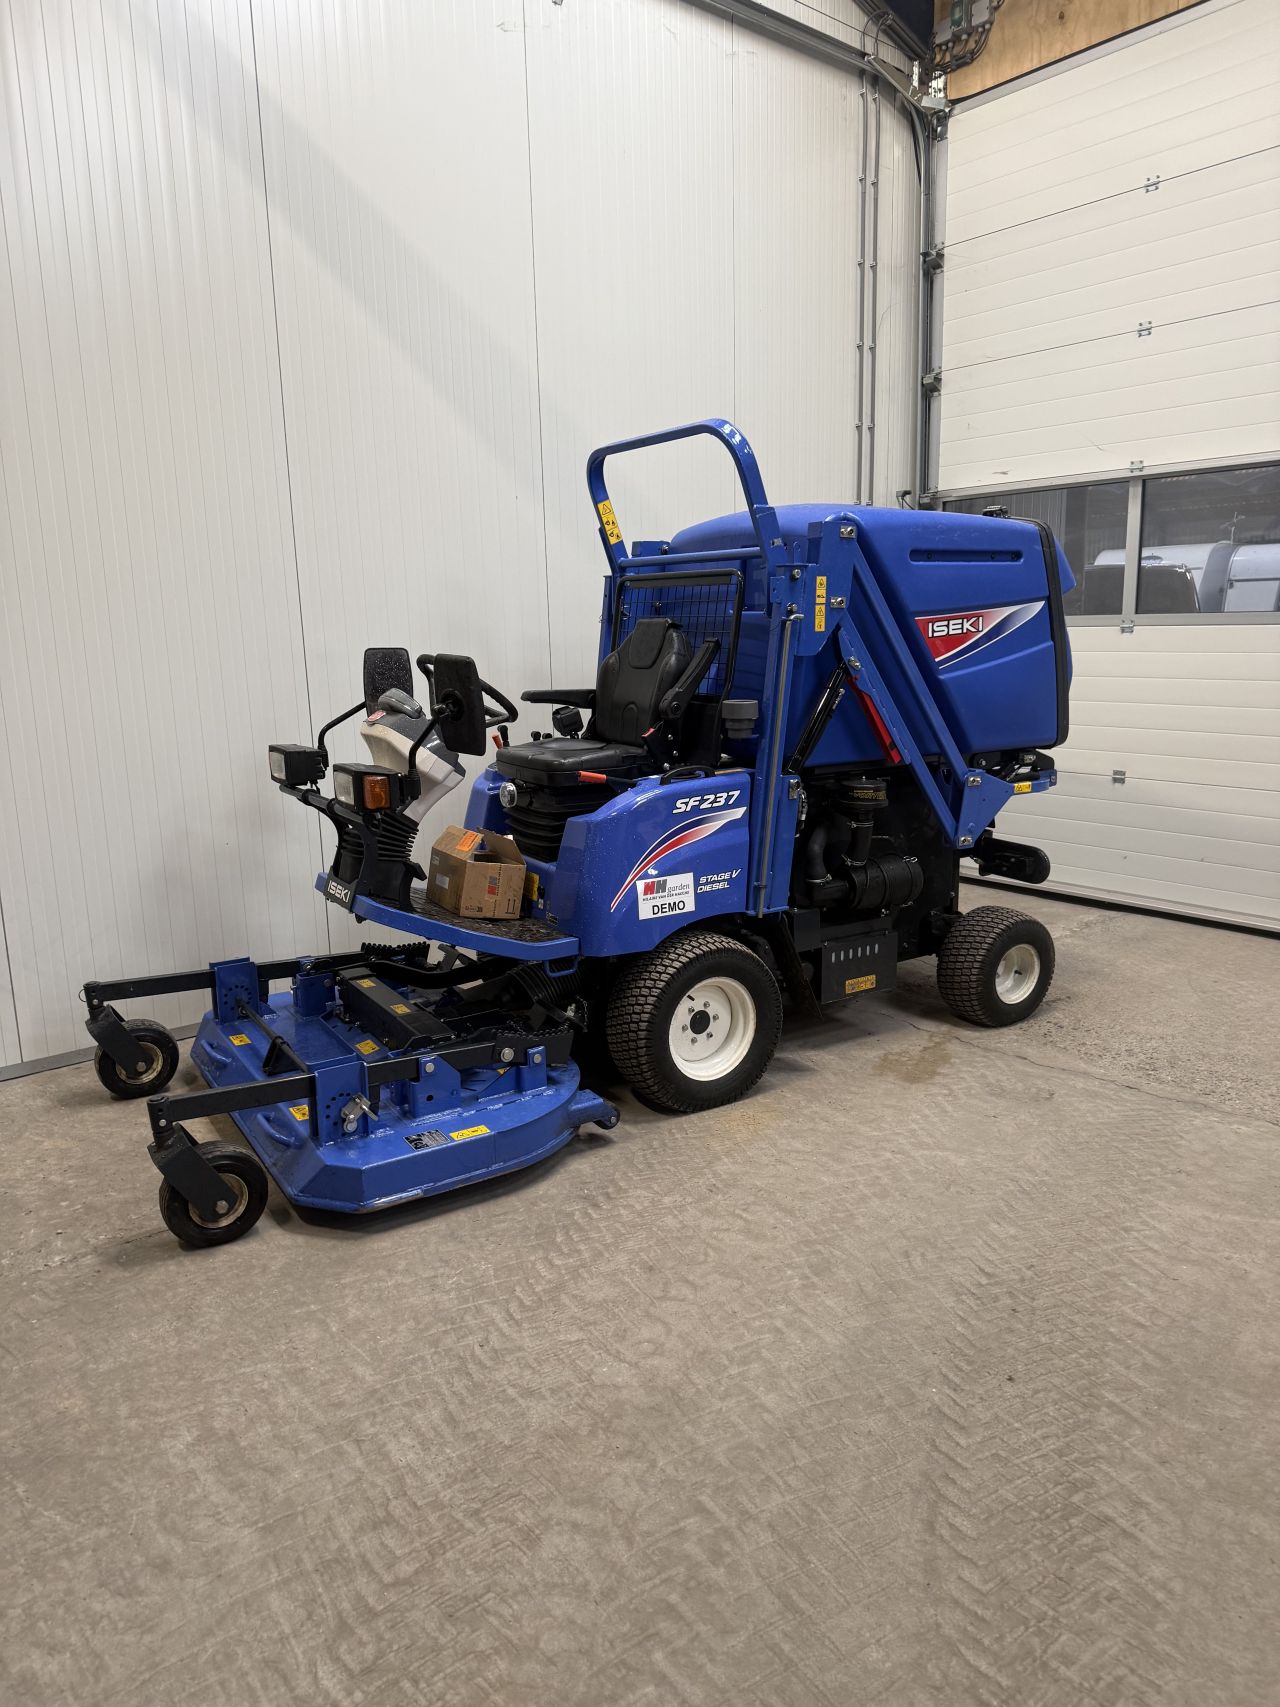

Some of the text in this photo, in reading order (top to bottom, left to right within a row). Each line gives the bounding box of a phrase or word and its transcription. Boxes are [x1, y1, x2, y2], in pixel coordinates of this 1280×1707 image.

[928, 616, 983, 638] ISEKI
[672, 790, 741, 814] SF237
[699, 868, 742, 883] STAGE V
[327, 880, 351, 903] ISEKI
[667, 883, 690, 893] garden
[697, 881, 730, 893] DIESEL
[652, 900, 686, 916] DEMO
